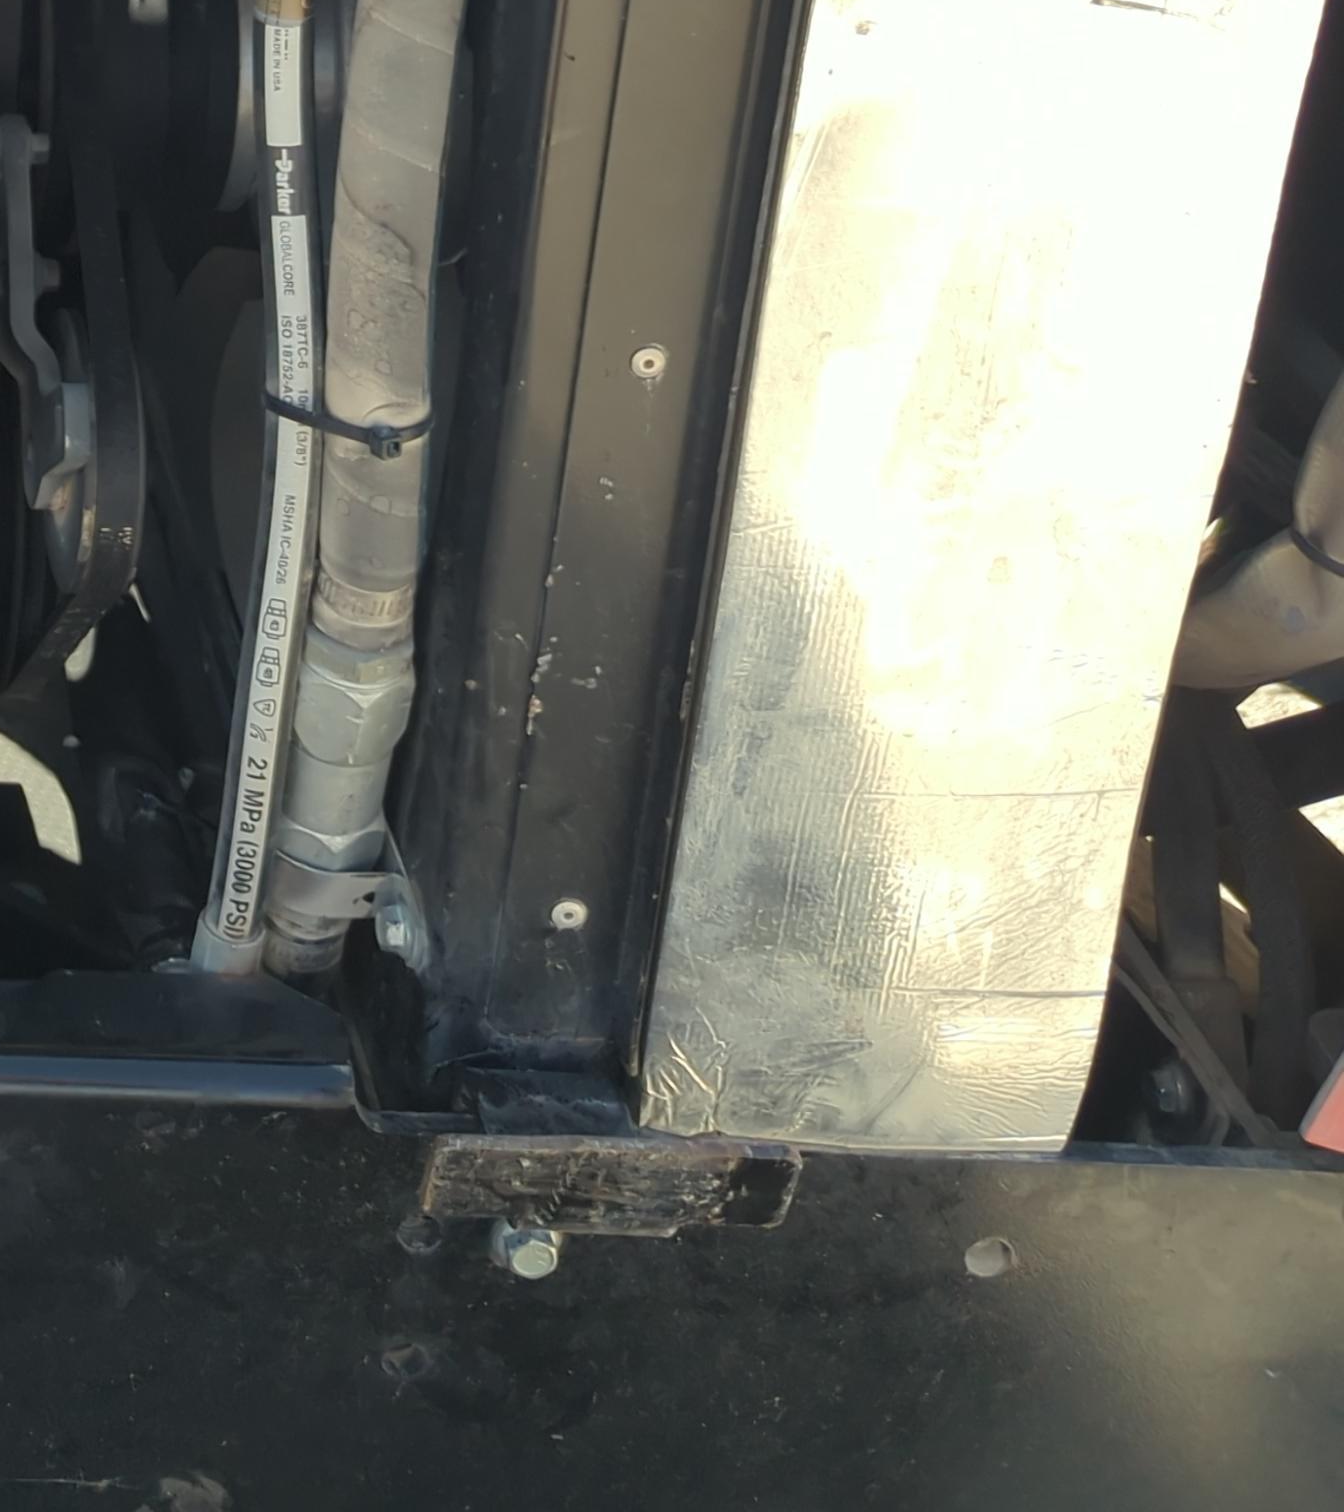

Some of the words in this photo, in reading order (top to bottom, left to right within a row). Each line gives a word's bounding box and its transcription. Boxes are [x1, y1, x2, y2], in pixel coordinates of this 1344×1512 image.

[273, 28, 283, 59] MADE
[273, 59, 282, 71] IN
[273, 71, 283, 93] USA
[274, 148, 296, 216] Parker
[280, 314, 293, 340] ISO
[281, 493, 297, 533] MSHA
[245, 754, 268, 782] 21
[239, 787, 265, 835] MPa
[230, 839, 260, 896] (3000
[221, 898, 250, 939] PSI)
